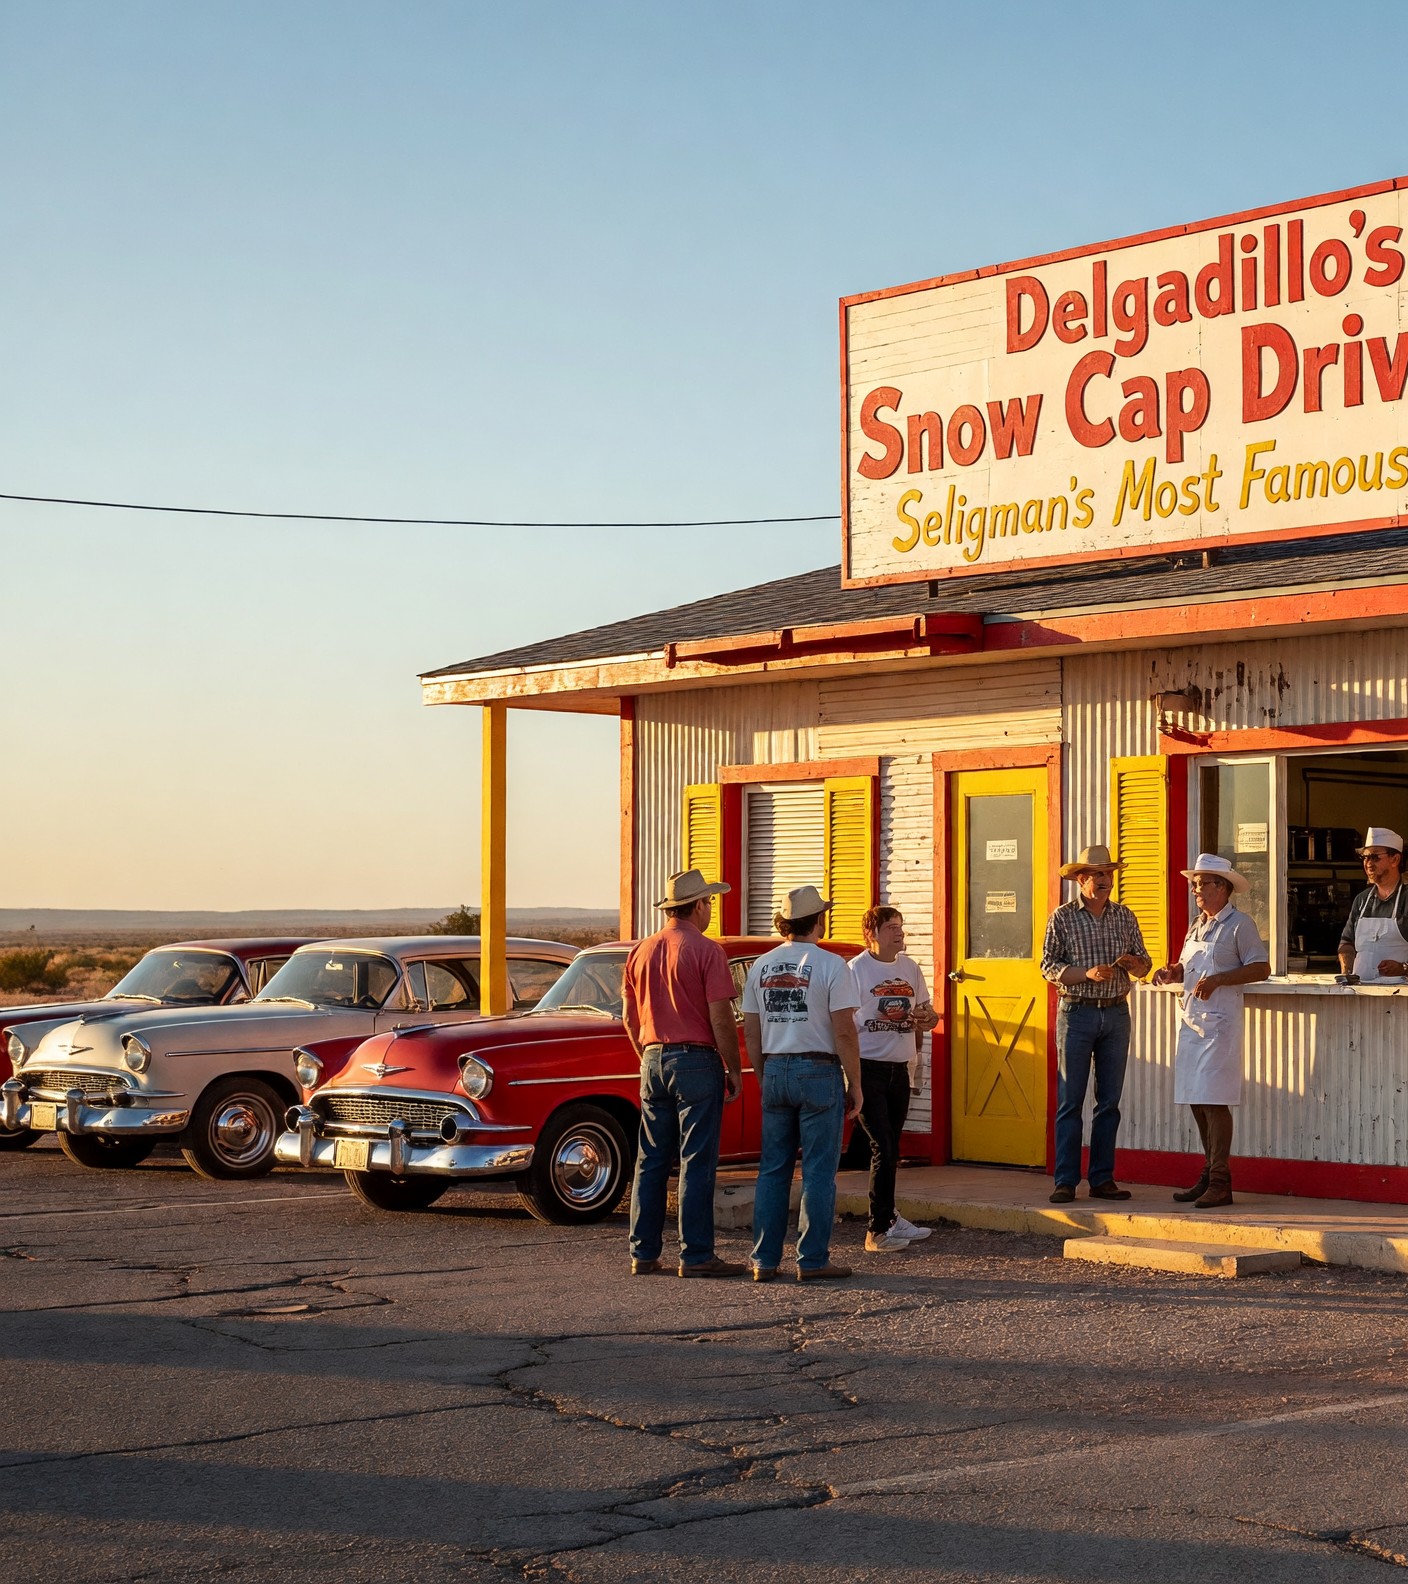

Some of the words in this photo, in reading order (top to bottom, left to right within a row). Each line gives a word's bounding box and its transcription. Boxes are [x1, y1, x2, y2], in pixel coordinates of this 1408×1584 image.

[1006, 210, 1405, 358] Delgadillo's
[857, 386, 1044, 480] Snow
[1065, 350, 1211, 464] Cap
[892, 475, 1096, 562] Seligman's
[1112, 453, 1224, 527] Most
